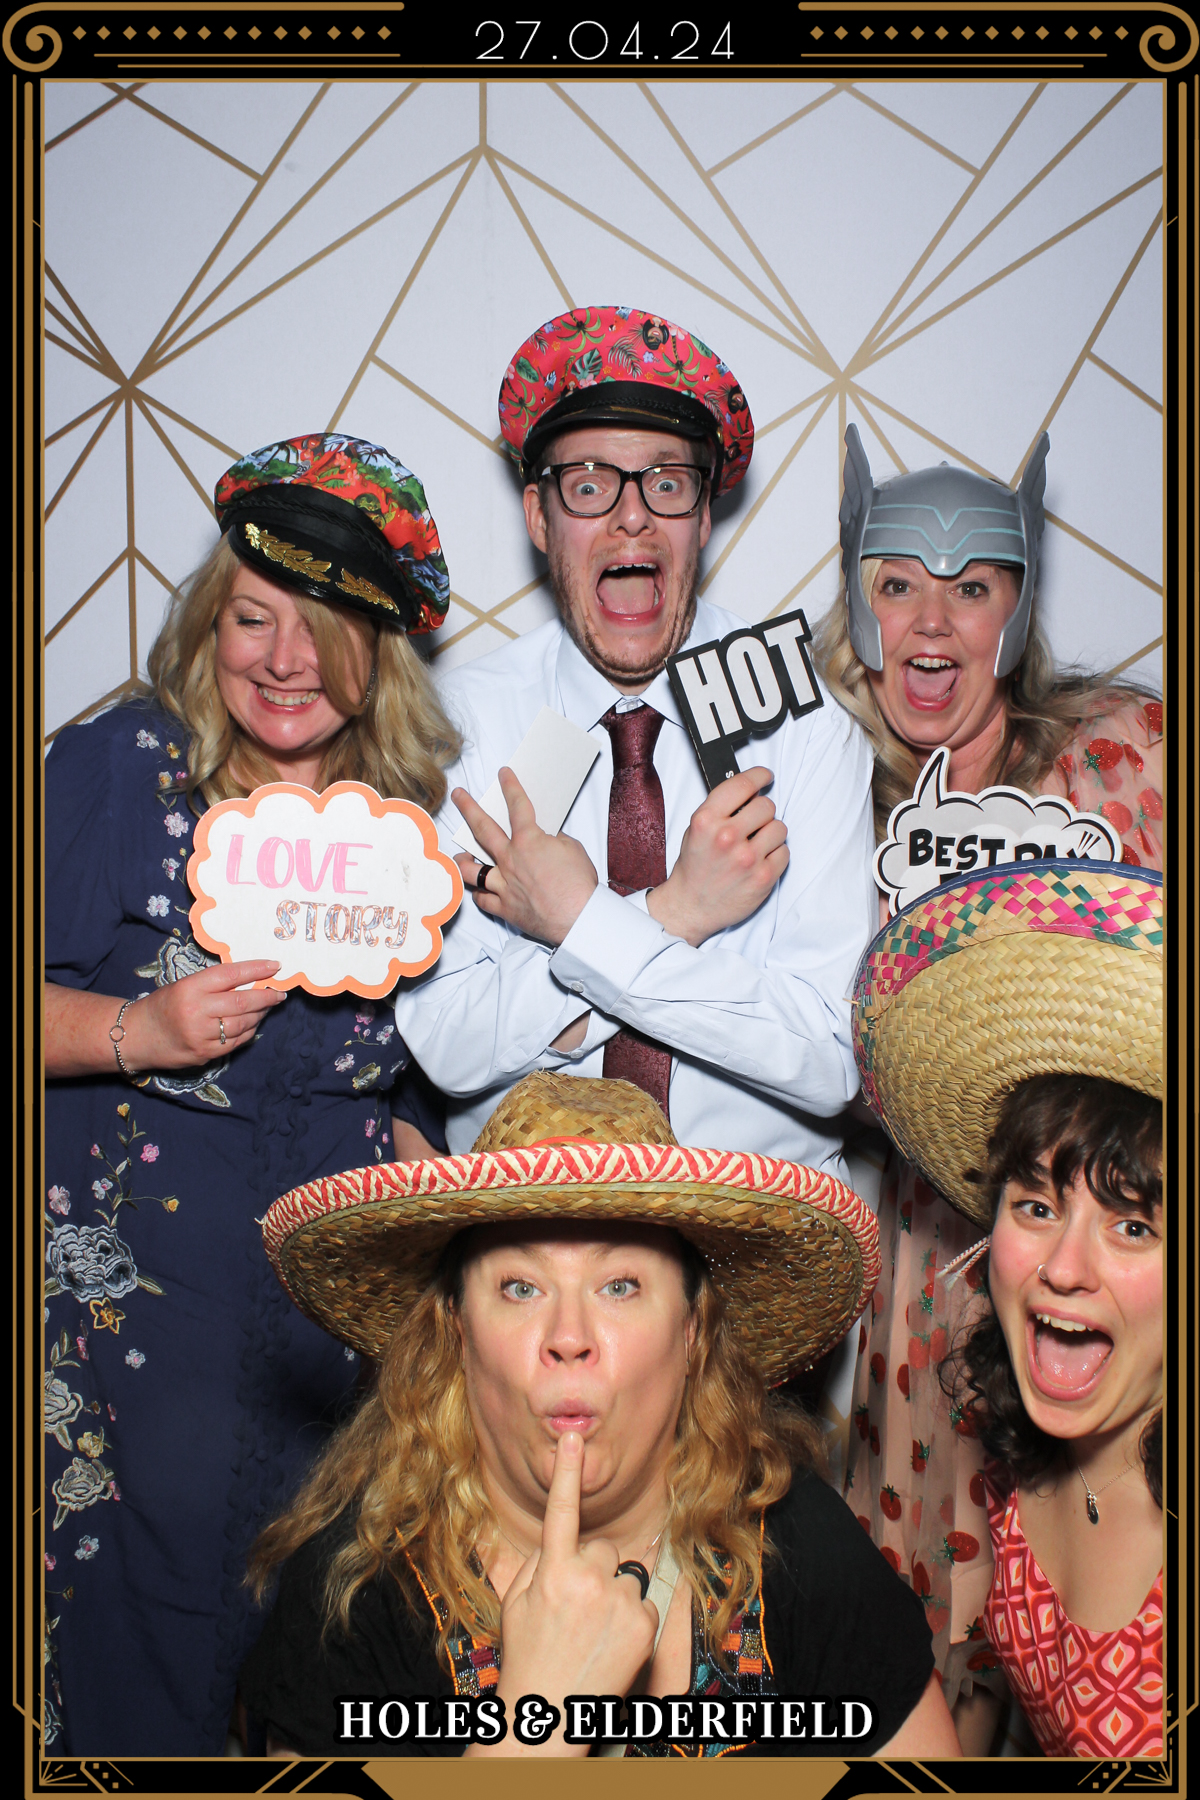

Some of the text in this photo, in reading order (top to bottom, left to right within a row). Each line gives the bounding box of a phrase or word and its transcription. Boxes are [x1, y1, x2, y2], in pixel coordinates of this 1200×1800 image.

[675, 618, 817, 744] HOT
[226, 834, 374, 895] LOVE
[909, 828, 1006, 870] BEST
[273, 899, 409, 949] STORY
